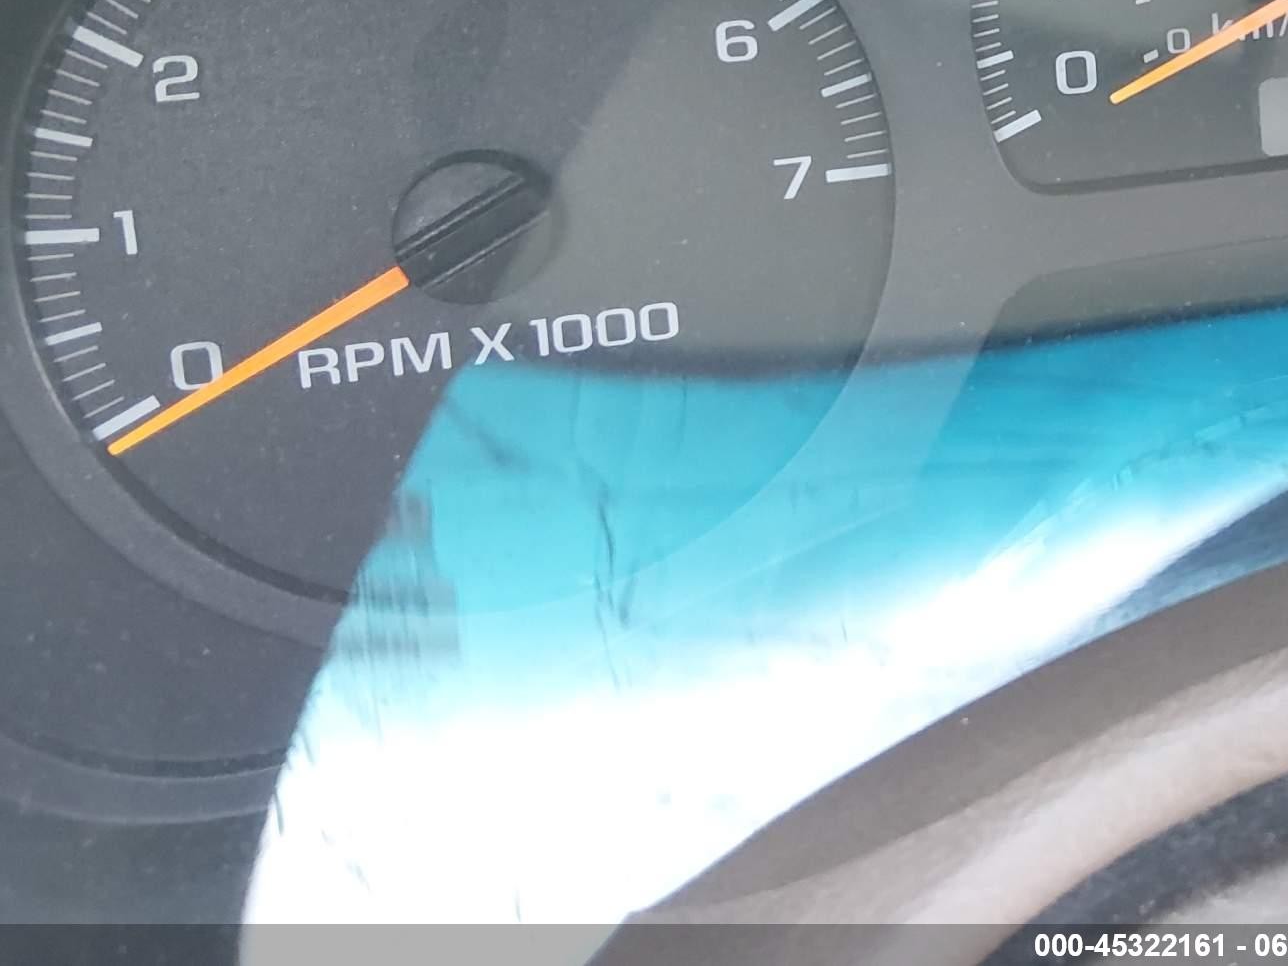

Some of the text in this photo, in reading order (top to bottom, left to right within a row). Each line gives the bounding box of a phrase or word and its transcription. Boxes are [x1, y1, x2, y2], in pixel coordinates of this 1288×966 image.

[716, 20, 757, 62] 6
[153, 55, 199, 102] 2
[1056, 51, 1097, 94] 0
[774, 156, 811, 199] 7
[114, 210, 137, 254] 1
[171, 342, 224, 392] 0
[298, 303, 678, 388] RPM X 1000
